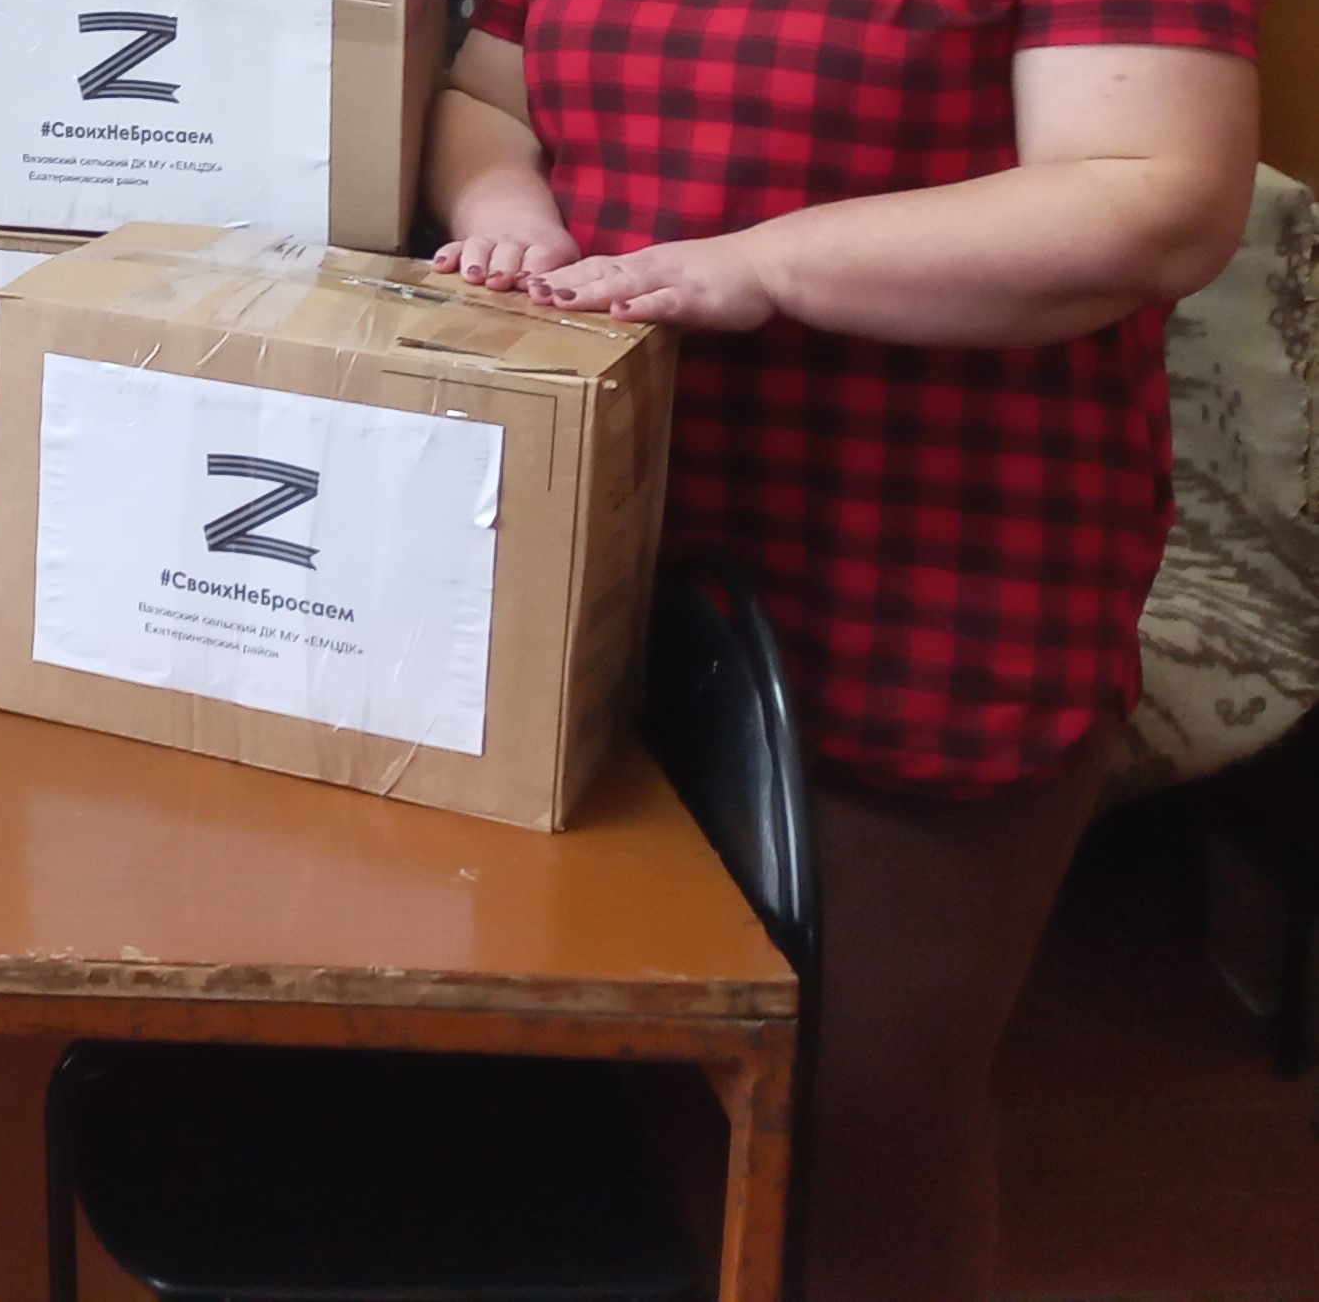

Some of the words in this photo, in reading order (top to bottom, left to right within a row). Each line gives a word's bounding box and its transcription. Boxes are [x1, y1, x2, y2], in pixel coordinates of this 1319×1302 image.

[41, 121, 213, 145] #СвоихНеБросаем
[130, 159, 146, 169] ДК
[148, 160, 165, 170] МУ
[160, 568, 355, 623] #СвоихНеБросаем
[259, 626, 276, 639] ДК
[280, 629, 300, 643] МУ
